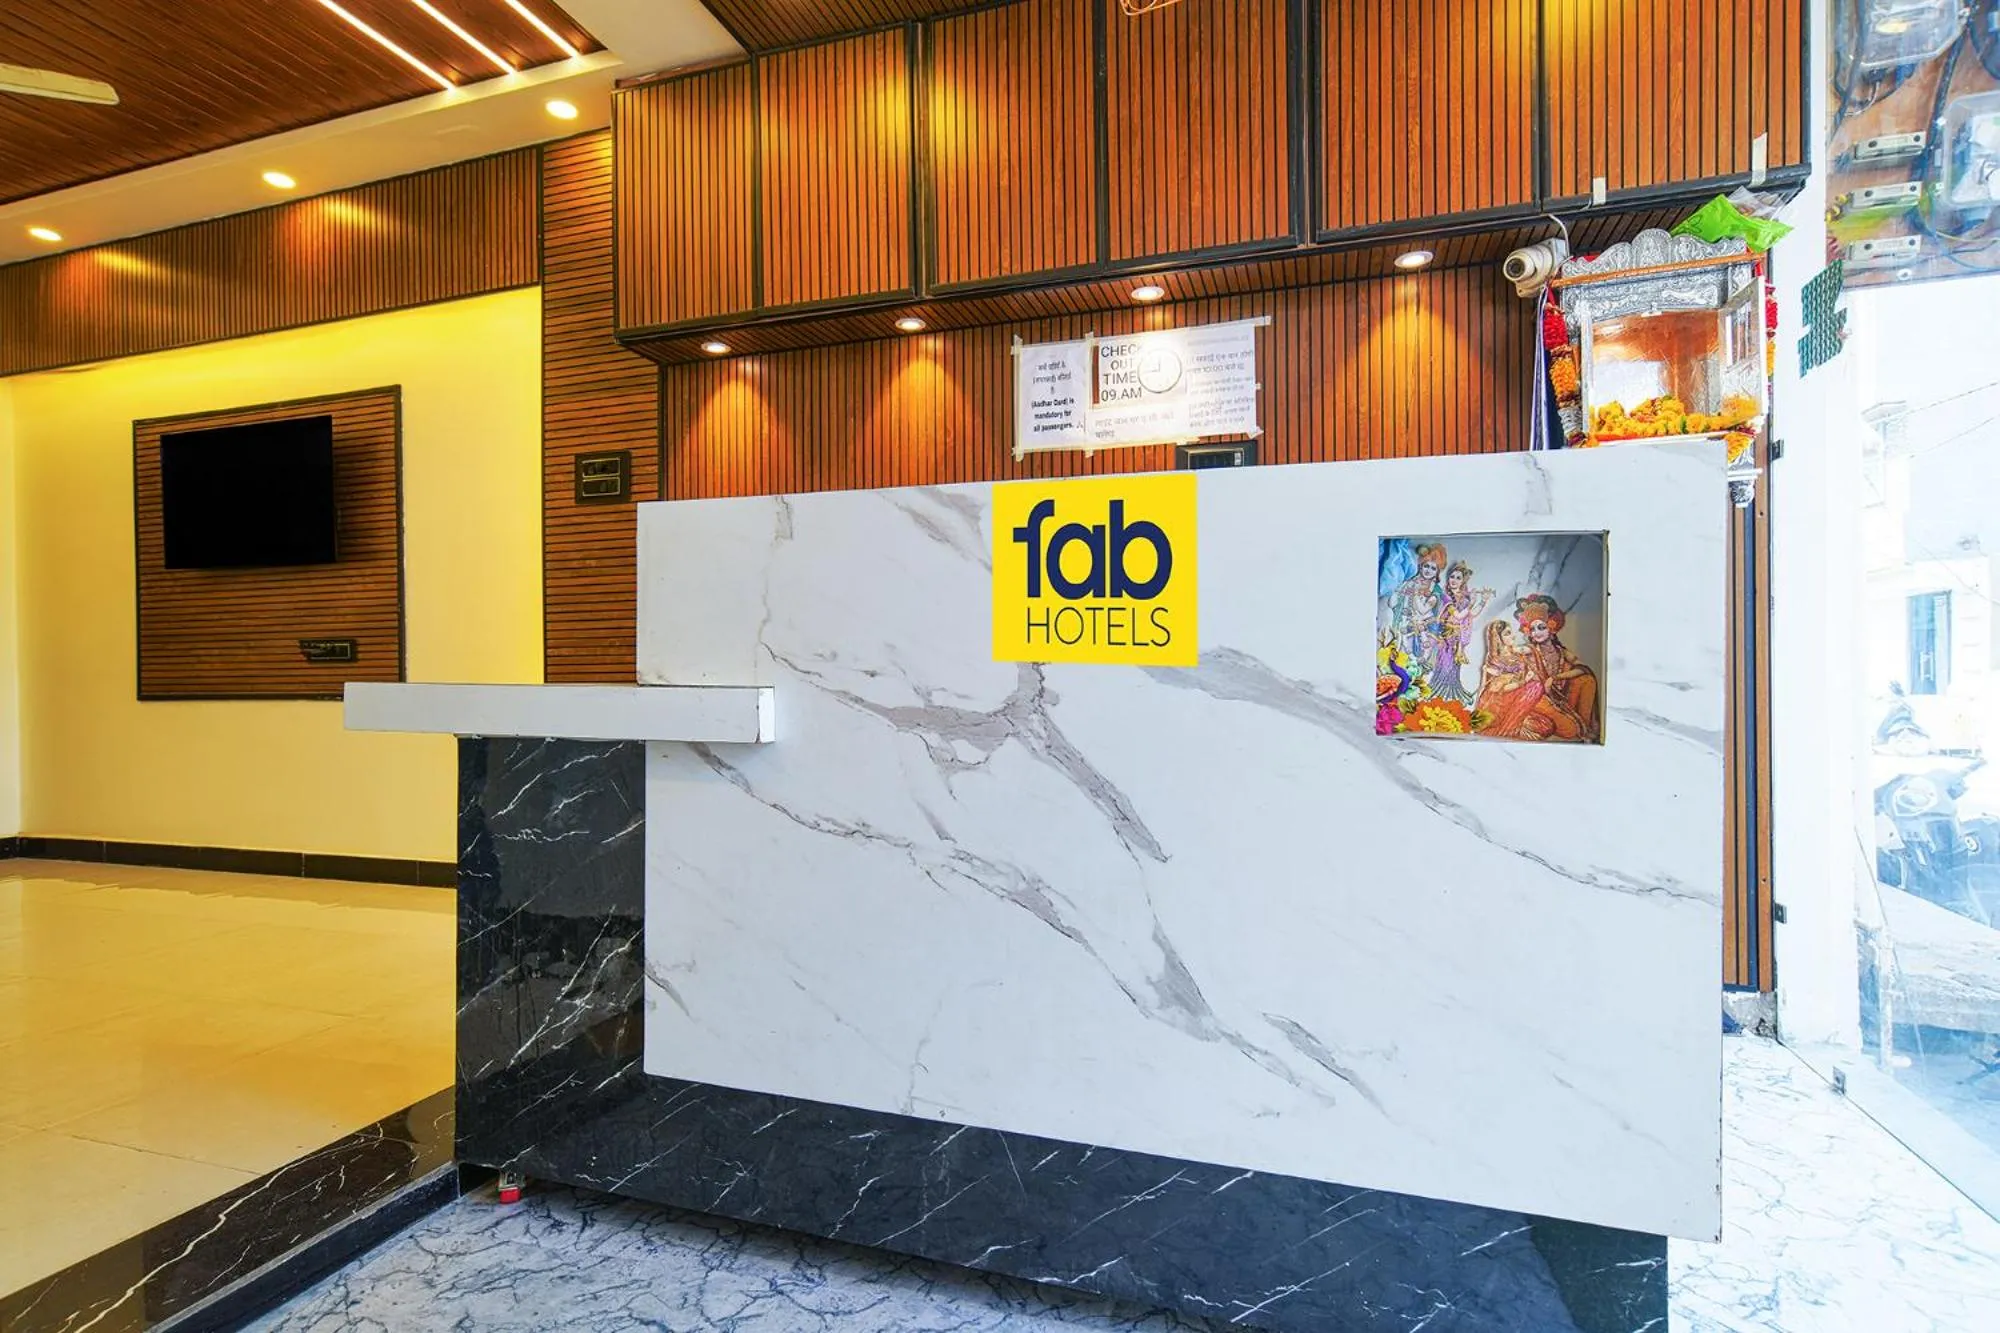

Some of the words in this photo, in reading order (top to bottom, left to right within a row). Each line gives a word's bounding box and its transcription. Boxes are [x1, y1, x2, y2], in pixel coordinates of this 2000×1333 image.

[1110, 358, 1136, 371] OUT
[1103, 370, 1138, 385] TIME
[1101, 386, 1143, 402] 09.AM
[1013, 499, 1173, 600] fab
[1027, 606, 1171, 647] HOTELS
